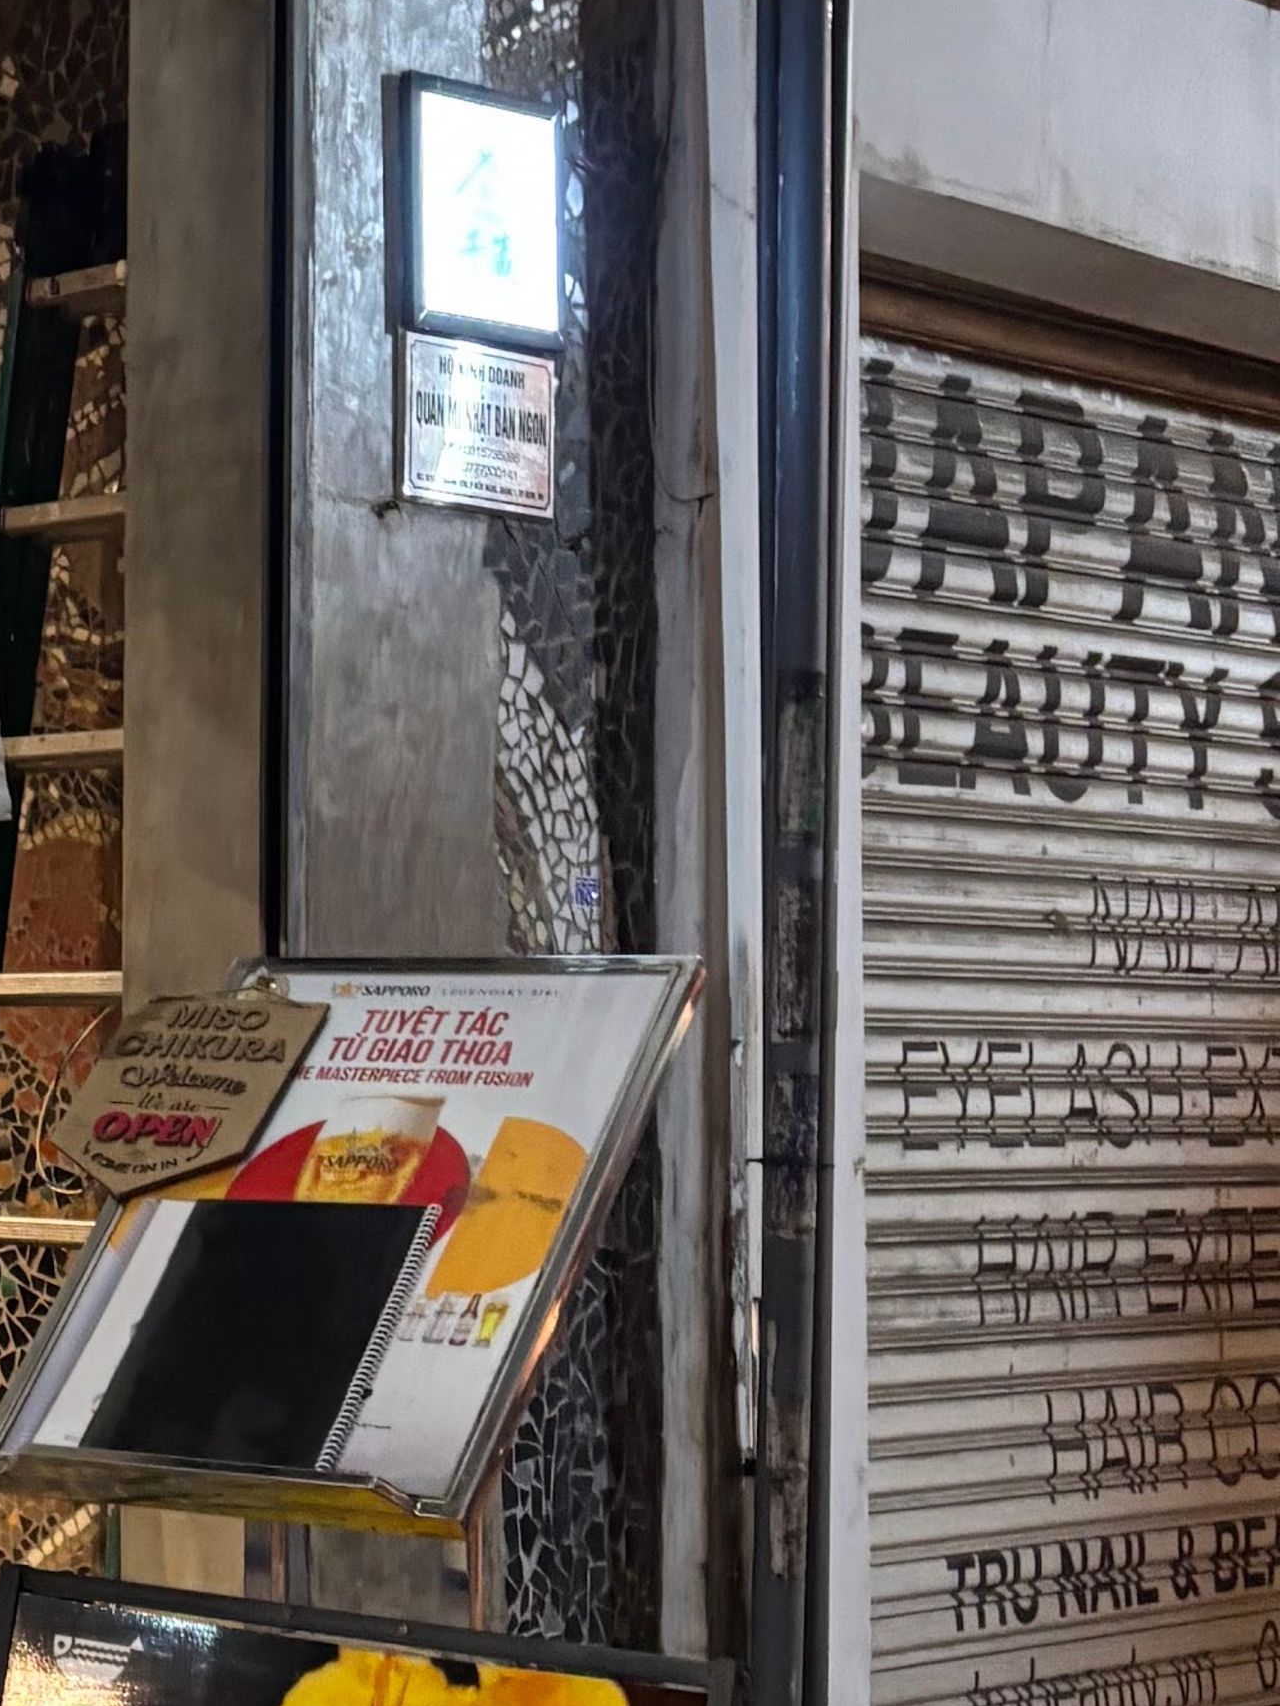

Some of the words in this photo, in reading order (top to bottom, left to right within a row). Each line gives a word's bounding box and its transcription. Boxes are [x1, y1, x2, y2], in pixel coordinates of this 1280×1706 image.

[361, 984, 430, 997] SAPPORO
[167, 1005, 270, 1031] MISO
[361, 1005, 449, 1037] TUYỆT
[454, 1006, 509, 1036] TÁC
[113, 1030, 286, 1063] CHIKURA
[366, 1037, 434, 1064] GIAO
[439, 1039, 513, 1066] THOA
[316, 1066, 425, 1084] MASTERPIECE
[425, 1070, 471, 1085] FROM
[474, 1071, 534, 1087] FUSION
[898, 1040, 1184, 1151] EYELASH
[1204, 1042, 1280, 1149] EX
[93, 1110, 223, 1148] OPEN
[132, 1163, 157, 1174] ON
[161, 1158, 178, 1171] IN
[325, 1154, 397, 1172] SAPPORO
[972, 1213, 1120, 1327] HAIR
[1044, 1381, 1189, 1505] HAIR
[945, 1545, 1042, 1632] TRU
[1053, 1533, 1159, 1619] NAIL
[1170, 1524, 1200, 1600] &
